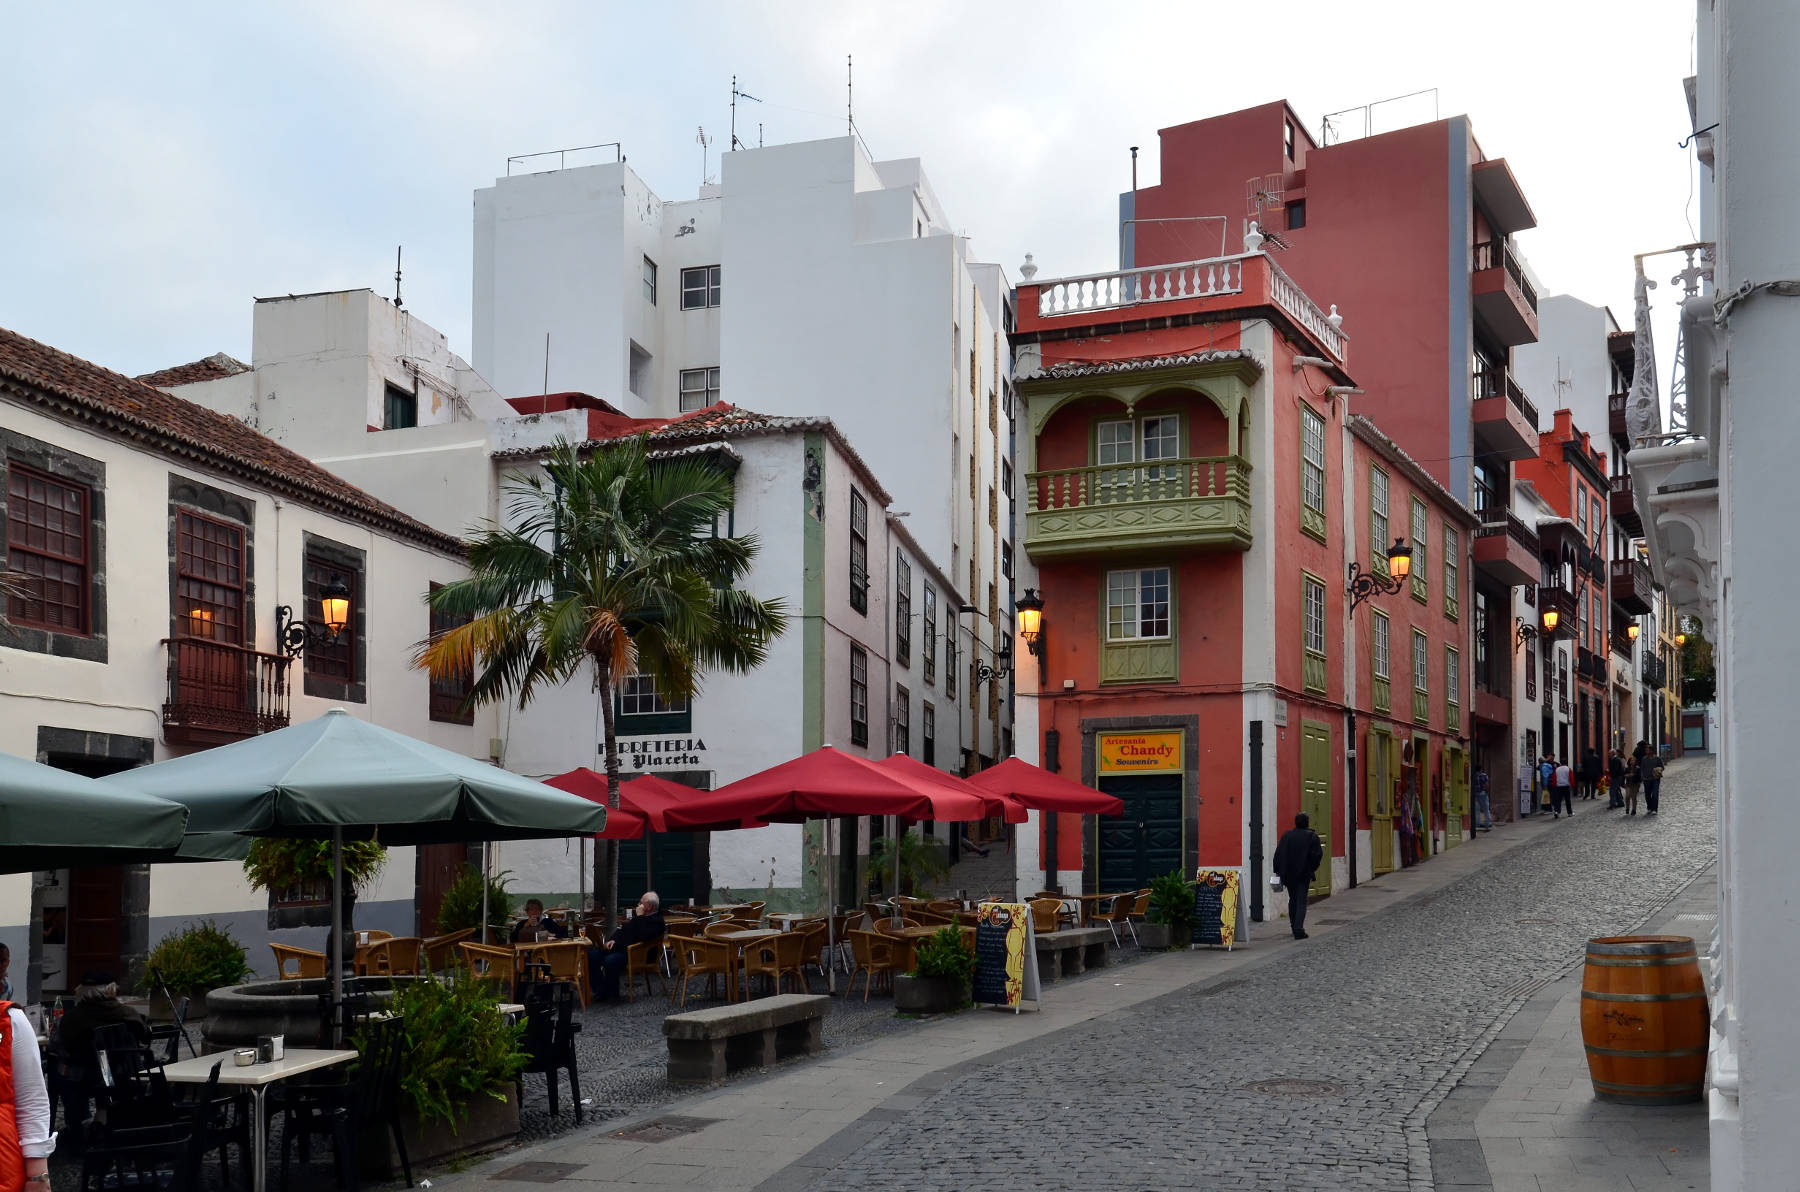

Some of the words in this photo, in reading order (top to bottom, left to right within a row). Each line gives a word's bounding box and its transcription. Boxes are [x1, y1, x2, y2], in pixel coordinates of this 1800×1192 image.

[598, 738, 707, 755] FRRETERIA
[1120, 744, 1174, 758] Chandy
[1116, 757, 1159, 766] Souvenirs
